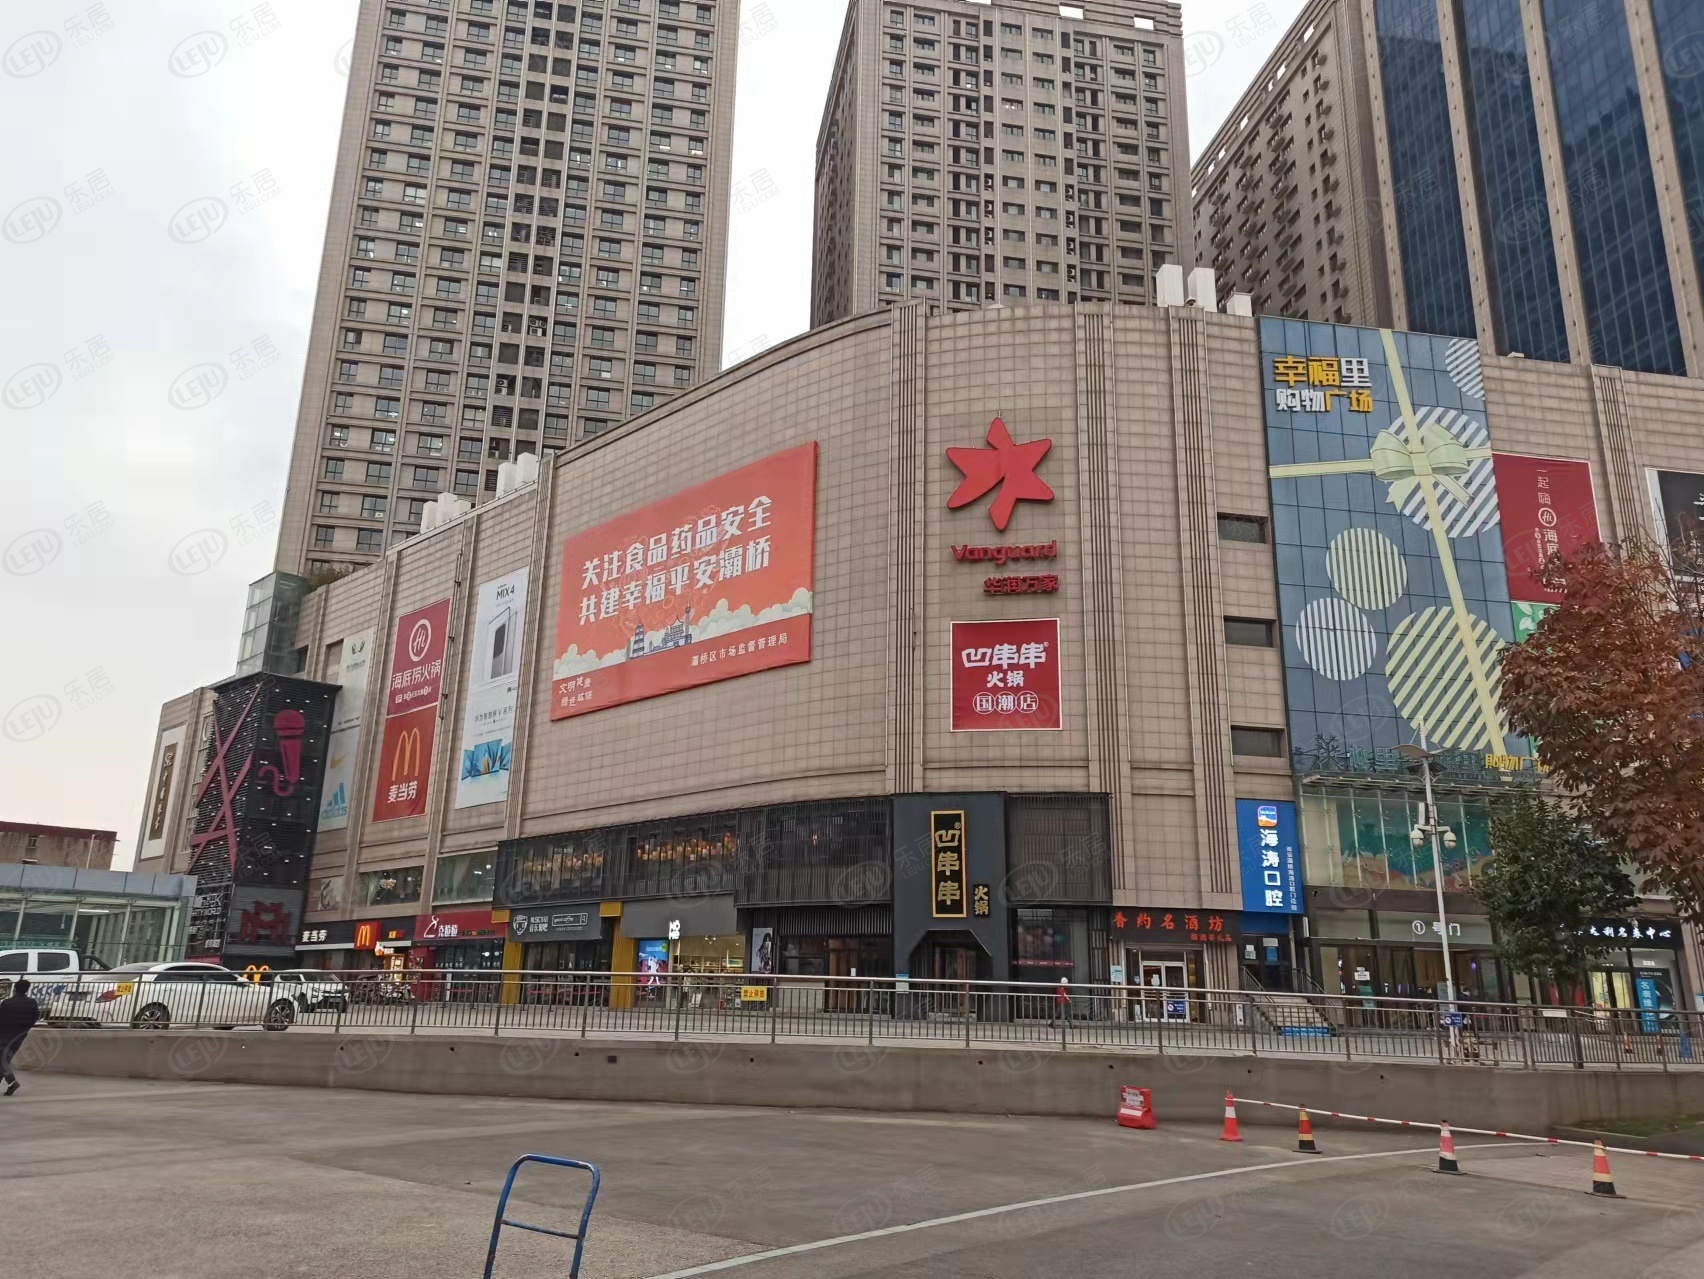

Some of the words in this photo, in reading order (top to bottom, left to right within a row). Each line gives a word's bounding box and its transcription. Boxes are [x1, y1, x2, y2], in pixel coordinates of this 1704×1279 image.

[1273, 355, 1373, 388] 幸福里
[1275, 388, 1374, 412] 购物广场
[581, 496, 773, 590] 关注食品药品安全
[951, 540, 1058, 566] Vanguard
[578, 535, 772, 626] 共建幸福平安灞桥
[983, 574, 1059, 594] 华润万家
[690, 632, 788, 667] 灞桥区市场监督管理局
[961, 641, 1047, 670] 凹串串
[391, 659, 442, 690] 海底捞火锅
[986, 670, 1025, 688] 火锅
[974, 692, 1039, 714] 国潮店
[387, 781, 418, 804] 麦当劳
[935, 829, 961, 906] 凹串串
[1260, 829, 1284, 907] 海涛口腔
[974, 885, 989, 915] 火锅
[302, 929, 328, 943] 麦当劳
